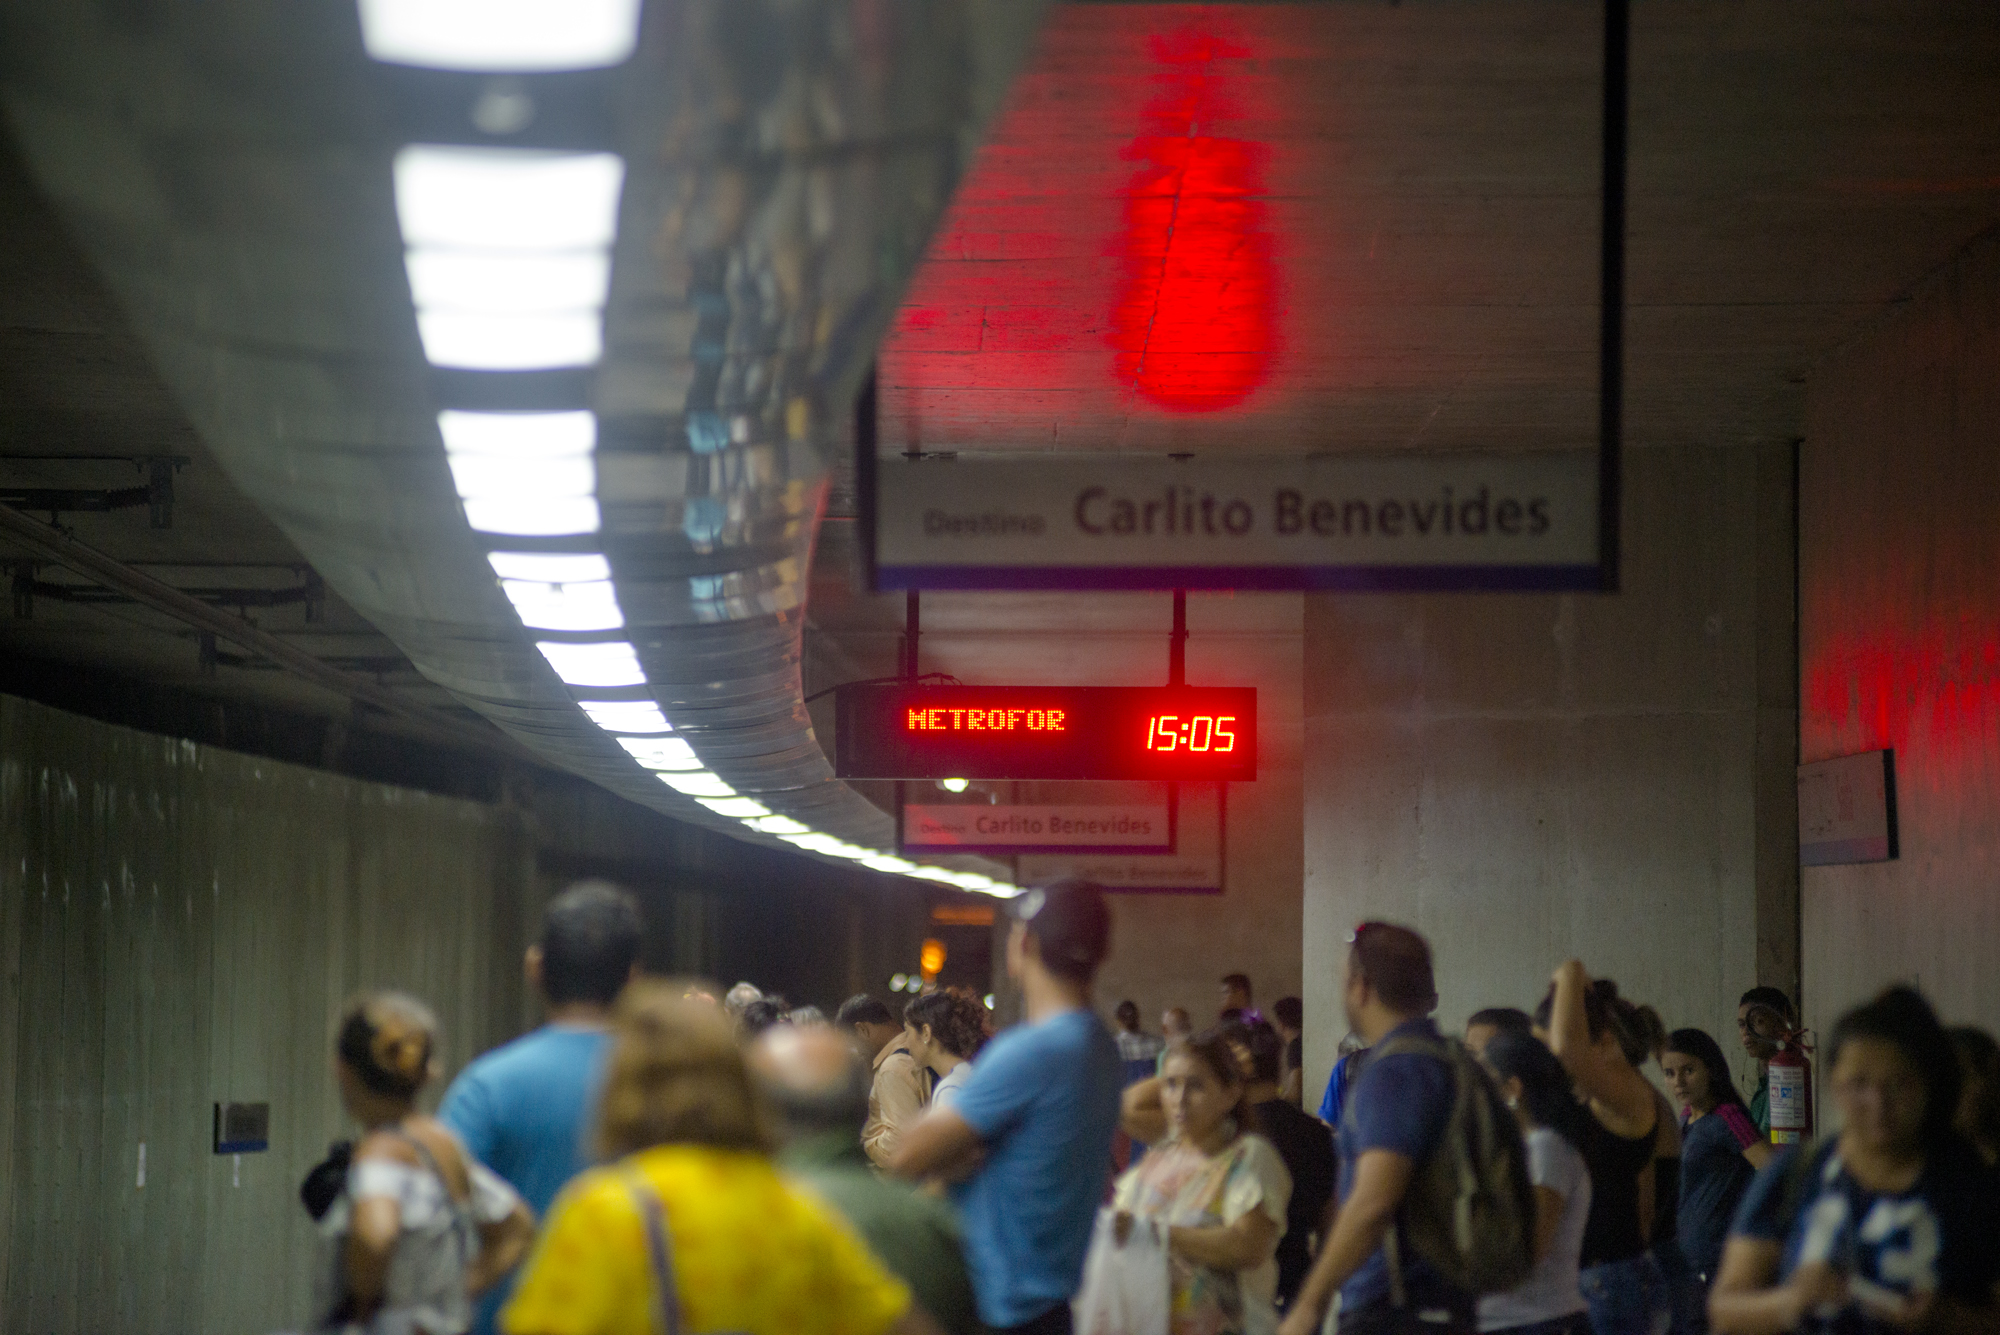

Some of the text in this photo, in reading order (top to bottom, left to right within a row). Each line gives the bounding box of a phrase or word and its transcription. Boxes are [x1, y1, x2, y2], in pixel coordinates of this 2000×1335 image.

[1074, 485, 1253, 535] Carlito
[1275, 485, 1549, 535] Benevides
[908, 708, 1236, 752] METROFOR 15:05
[976, 816, 1043, 835] Carlito
[1050, 815, 1152, 836] Benevides
